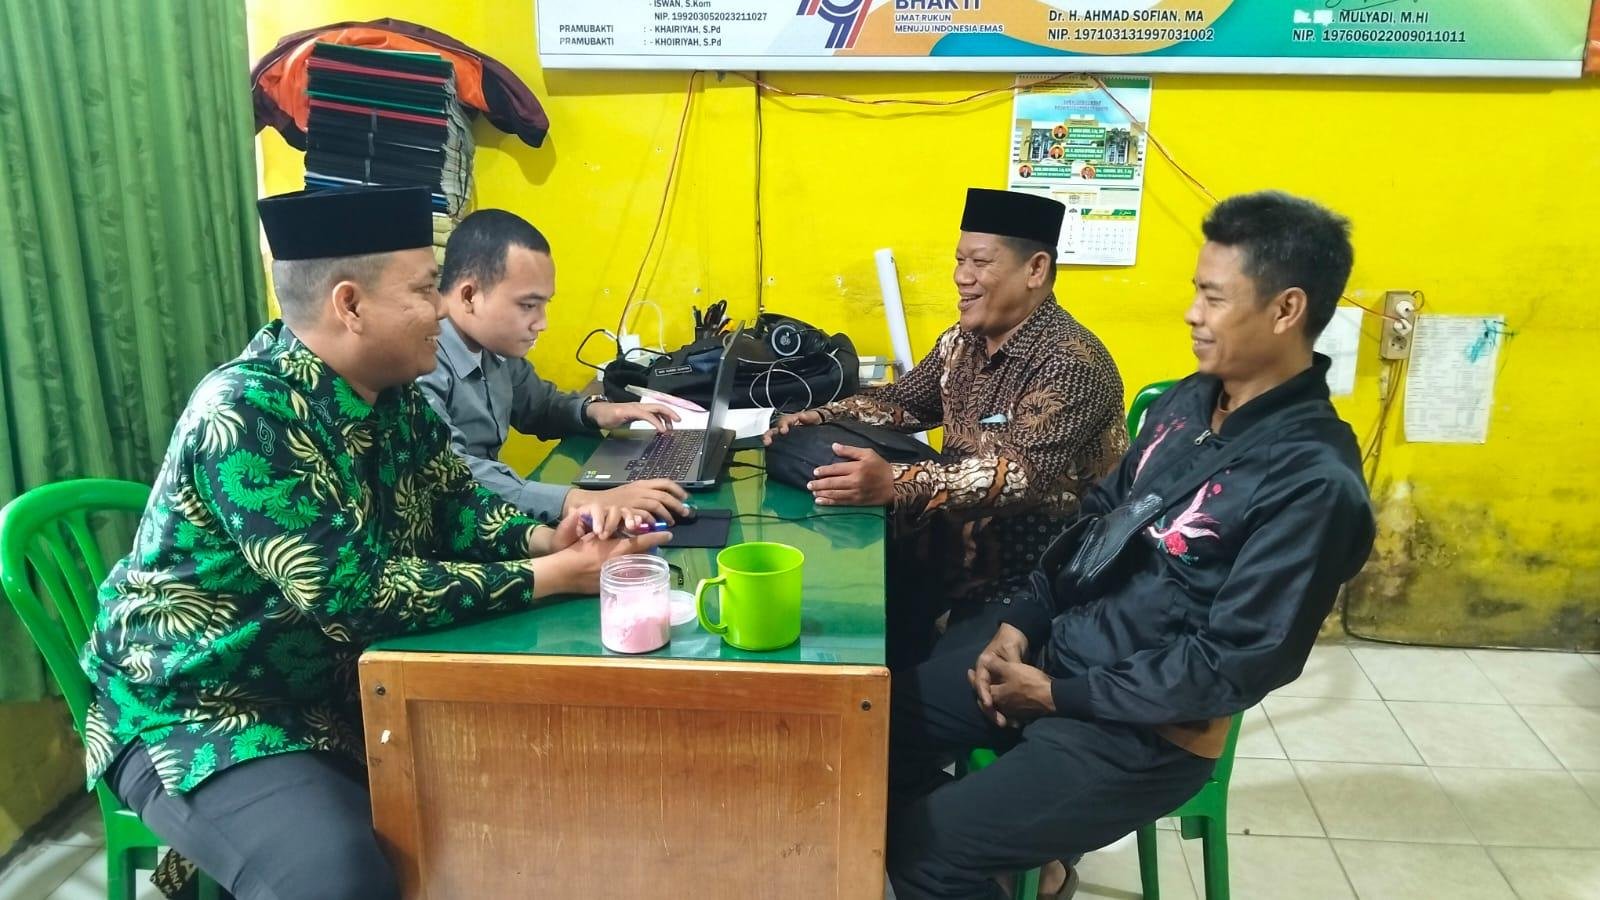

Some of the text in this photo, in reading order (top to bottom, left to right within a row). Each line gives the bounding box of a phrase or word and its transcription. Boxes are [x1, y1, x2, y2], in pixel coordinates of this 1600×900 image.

[653, 0, 683, 8] ISWAN,
[685, 0, 711, 8] S.Kom
[654, 12, 768, 21] NIP. 199203052023211027
[895, 14, 952, 22] UMAT RUKUN
[1049, 10, 1065, 21] Dr.
[1069, 10, 1080, 22] H.
[1084, 10, 1129, 22] AHMAD
[1185, 10, 1204, 22] MA
[1400, 12, 1428, 23] M.HI
[559, 24, 614, 33] PRAMUBAKTI
[654, 25, 701, 34] KHAIRIYAH,
[703, 25, 721, 34] S.Pd
[895, 24, 1004, 33] MENUJU INDONESIA EMAS
[1048, 28, 1214, 41] NIP. 197103131997031002
[1293, 29, 1466, 42] NIP. 197606022009011011
[559, 37, 614, 46] PRAMUBAKTI
[654, 38, 702, 47] KHOIRIYAH,
[703, 38, 722, 47] S.Pd
